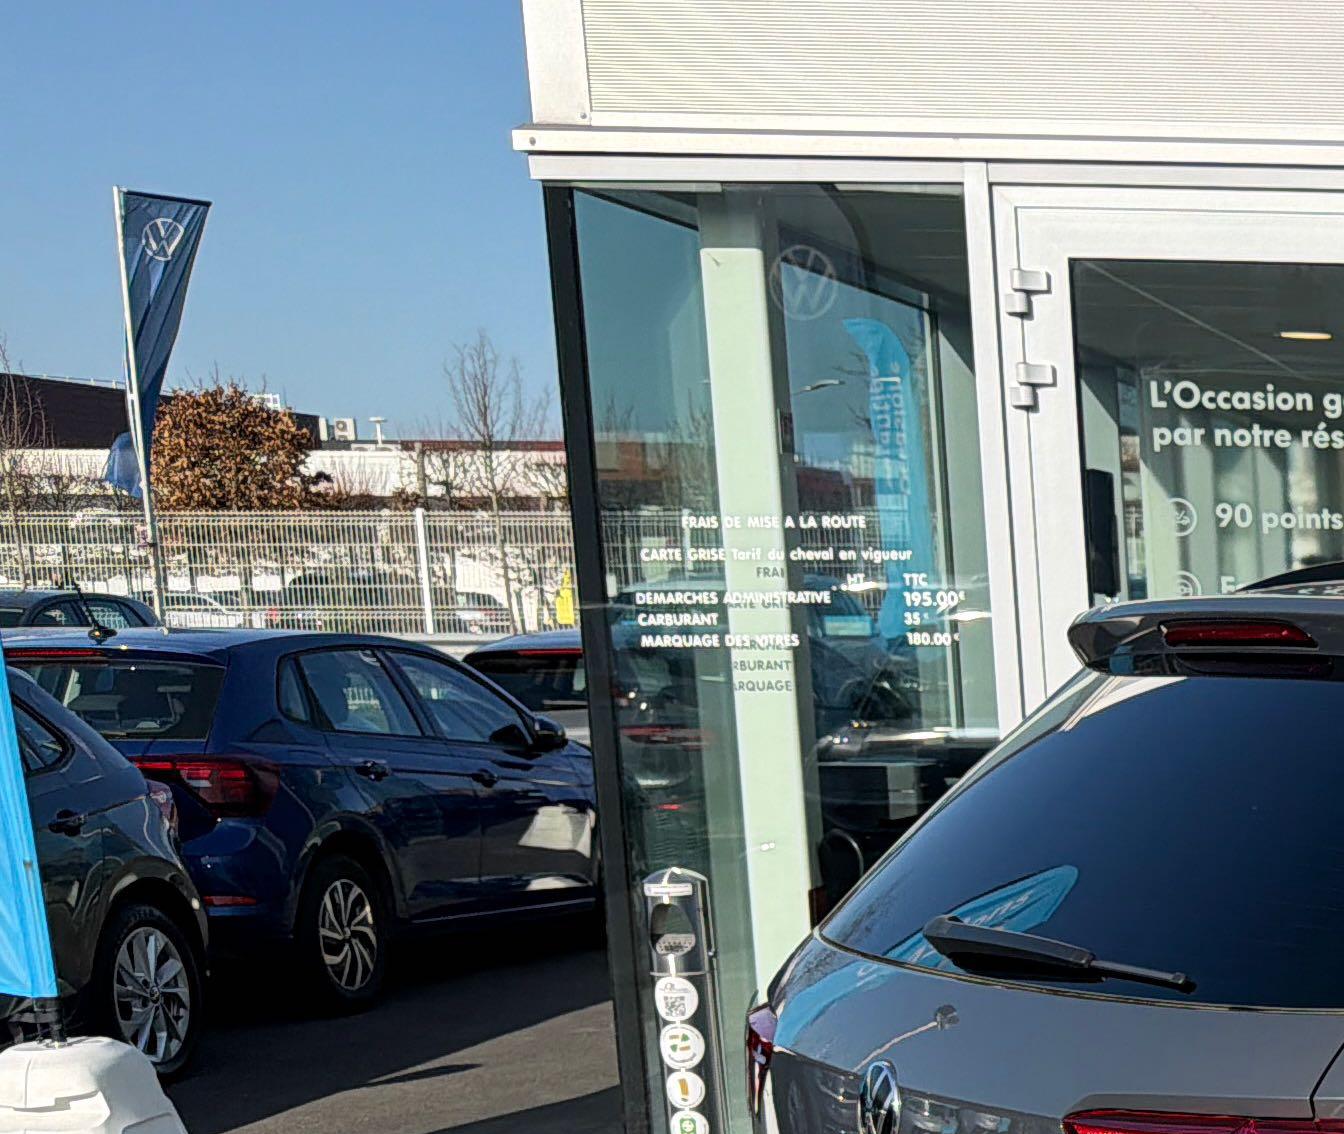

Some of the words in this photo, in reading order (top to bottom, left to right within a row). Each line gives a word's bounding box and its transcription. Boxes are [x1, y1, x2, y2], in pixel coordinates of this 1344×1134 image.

[1150, 380, 1313, 411] L'Occasion
[1153, 427, 1205, 452] par
[1214, 423, 1292, 448] notre
[681, 516, 718, 528] FRAIS
[723, 516, 741, 528] DE
[748, 516, 779, 528] MISE
[785, 516, 795, 528] A
[799, 516, 818, 528] LA
[822, 516, 866, 528] ROUTE
[1215, 503, 1253, 528] 90
[1262, 508, 1344, 534] points
[640, 548, 682, 561] CARTE
[688, 548, 726, 561] GRISE
[768, 547, 784, 561] du
[790, 547, 834, 561] cheval
[839, 550, 857, 561] en
[862, 547, 913, 564] vigueur
[846, 573, 865, 585] HT
[903, 573, 928, 586] TTC
[635, 592, 719, 605] DEMARCHES
[723, 591, 832, 604] ADMINISTRATIVE
[637, 613, 719, 626] CARBURANT
[641, 634, 720, 648] MARQUAGE
[724, 634, 750, 647] DES
